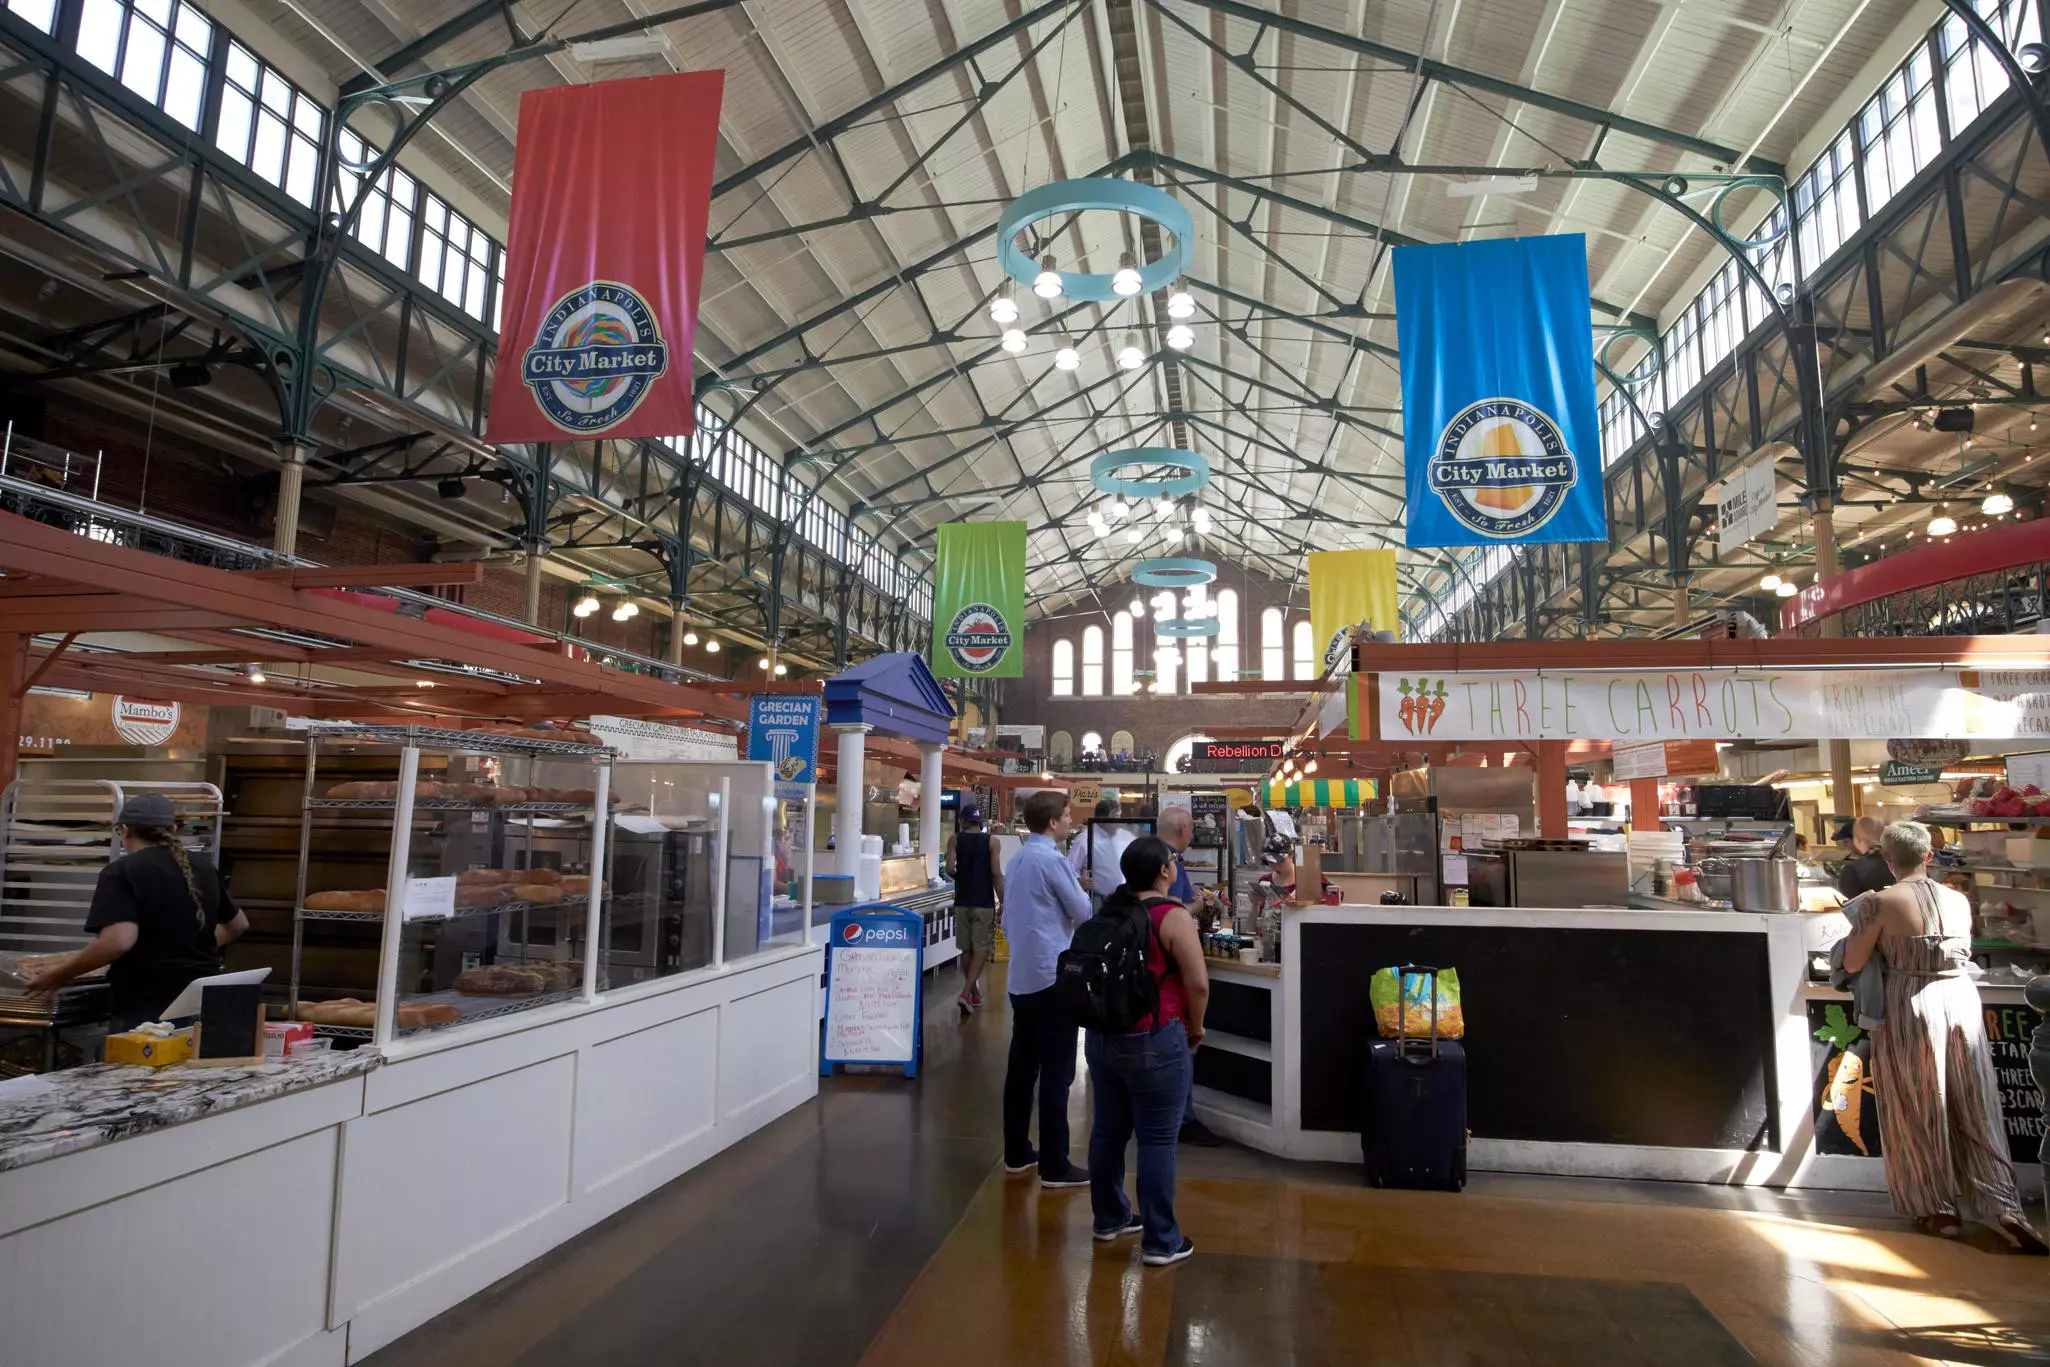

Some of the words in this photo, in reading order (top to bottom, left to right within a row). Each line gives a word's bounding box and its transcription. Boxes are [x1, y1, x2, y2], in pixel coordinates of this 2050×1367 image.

[542, 287, 651, 343] INDIANAPOLIS
[531, 355, 576, 375] City
[578, 350, 657, 370] Market
[557, 407, 573, 422] So
[578, 407, 617, 426] Fresh
[1445, 405, 1558, 455] INDIANAPOLIS
[1436, 465, 1483, 484] City
[1486, 461, 1568, 479] Market
[1471, 514, 1489, 527] So
[1494, 513, 1536, 530] Fresh
[948, 636, 969, 646] City
[970, 635, 1008, 644] Market
[1990, 671, 2020, 686] THREE
[1461, 676, 1577, 736] THREE
[1607, 672, 1793, 735] CARROTS
[1823, 684, 1866, 712] FROM
[1876, 683, 1908, 712] THE
[120, 702, 173, 719] Mambo's
[759, 701, 812, 713] GRECIAN
[618, 719, 651, 731] GRECIAN
[652, 724, 680, 735] GARDEN
[759, 714, 809, 726] GARDEN
[1207, 744, 1267, 757] Rebellion
[1072, 788, 1098, 799] Paris
[866, 928, 907, 942] pepsi
